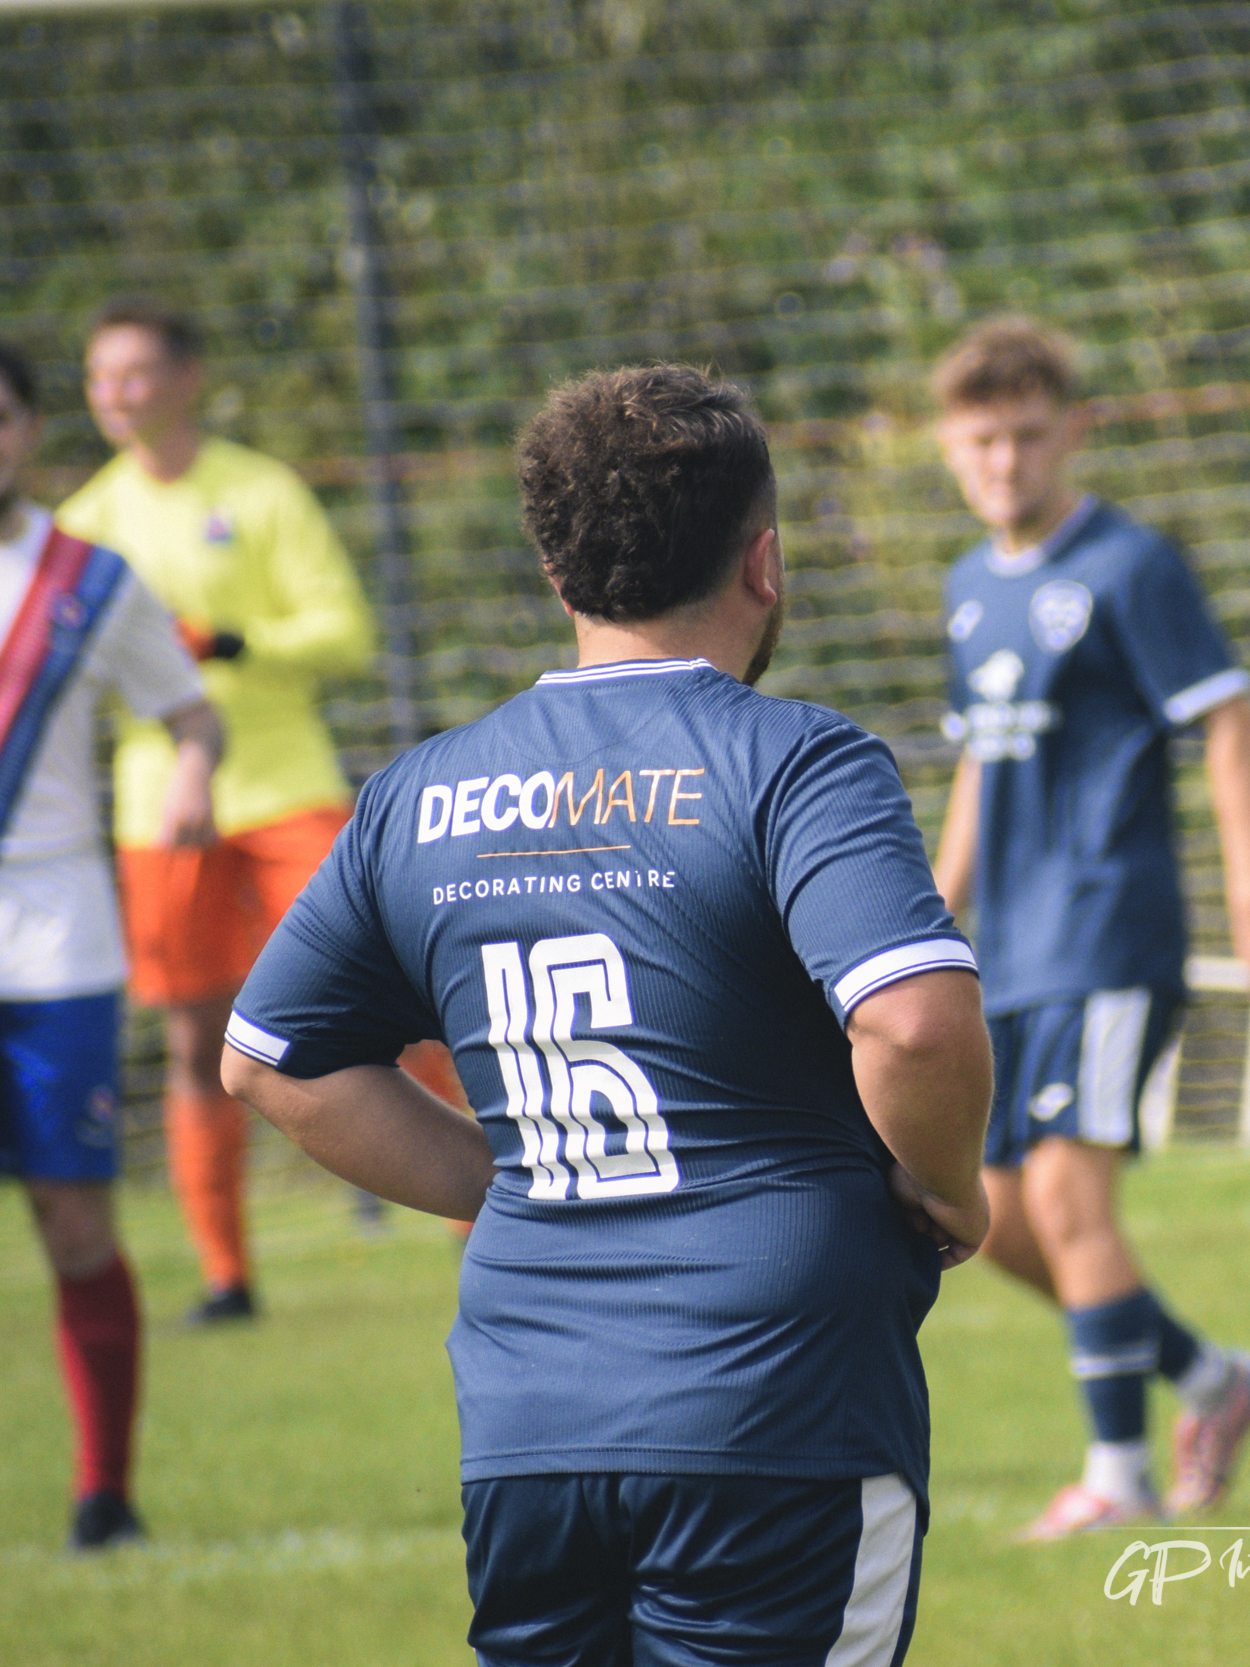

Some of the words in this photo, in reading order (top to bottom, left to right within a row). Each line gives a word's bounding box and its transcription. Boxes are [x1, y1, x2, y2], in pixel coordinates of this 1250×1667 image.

[417, 768, 705, 844] DECOMATE
[433, 874, 581, 905] DECORATING
[481, 933, 680, 1200] 16
